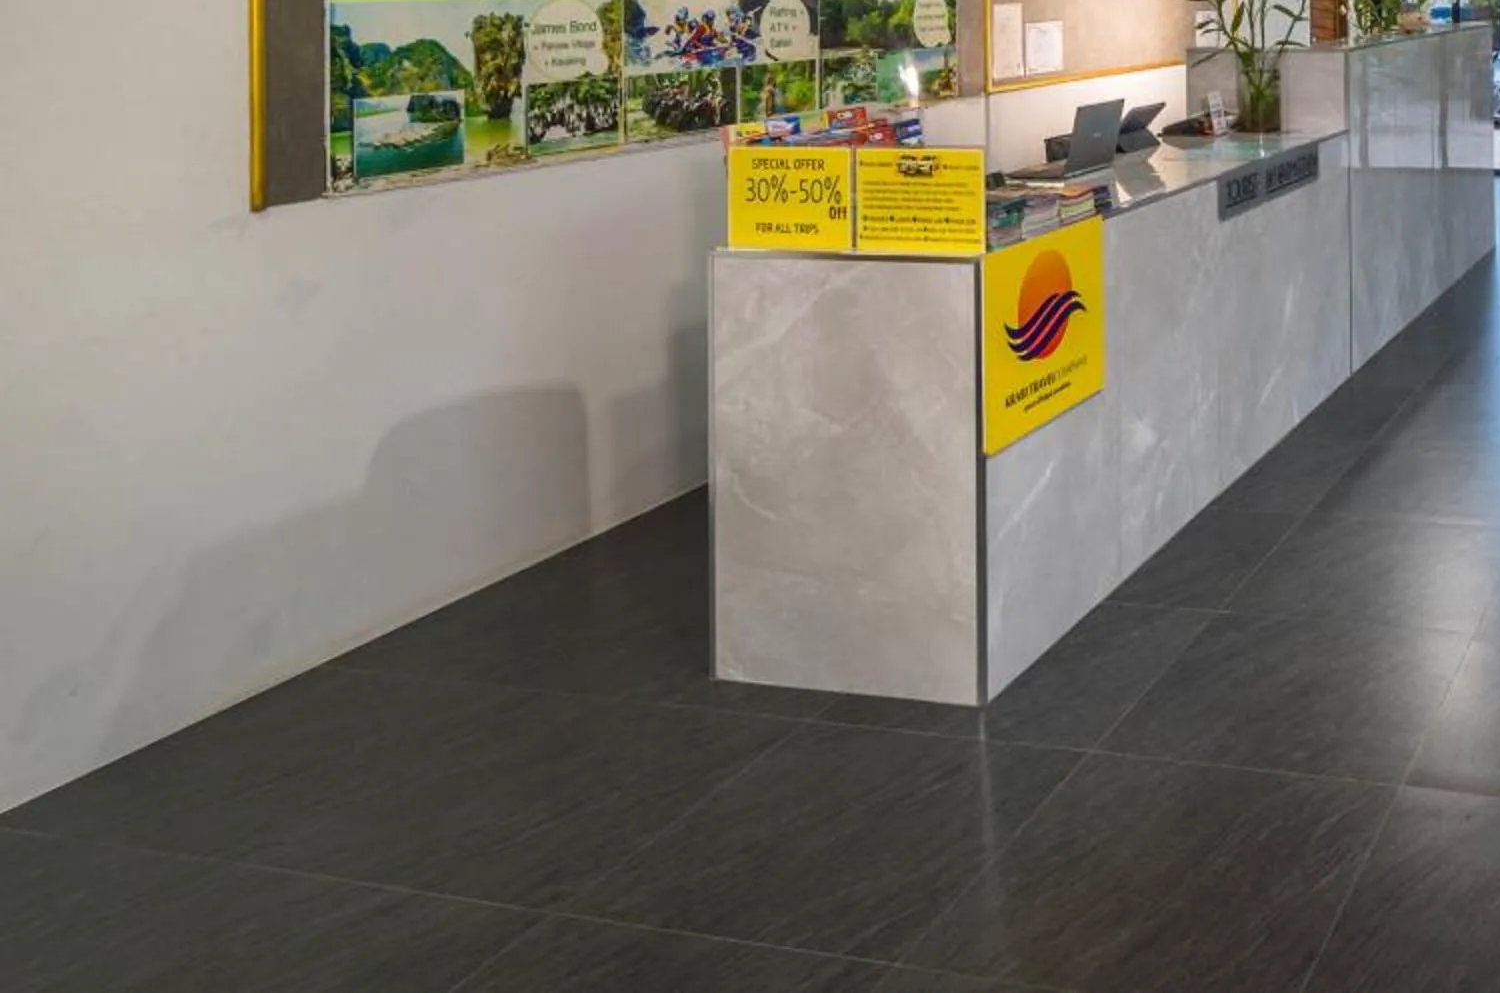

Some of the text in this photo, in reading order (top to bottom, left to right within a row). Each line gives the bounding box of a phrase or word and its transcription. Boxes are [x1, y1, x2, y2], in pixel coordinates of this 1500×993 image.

[751, 158, 825, 172] SPECIAL OFFER
[745, 173, 843, 205] 30%-50%
[755, 221, 820, 236] FOR ALL TRIPS
